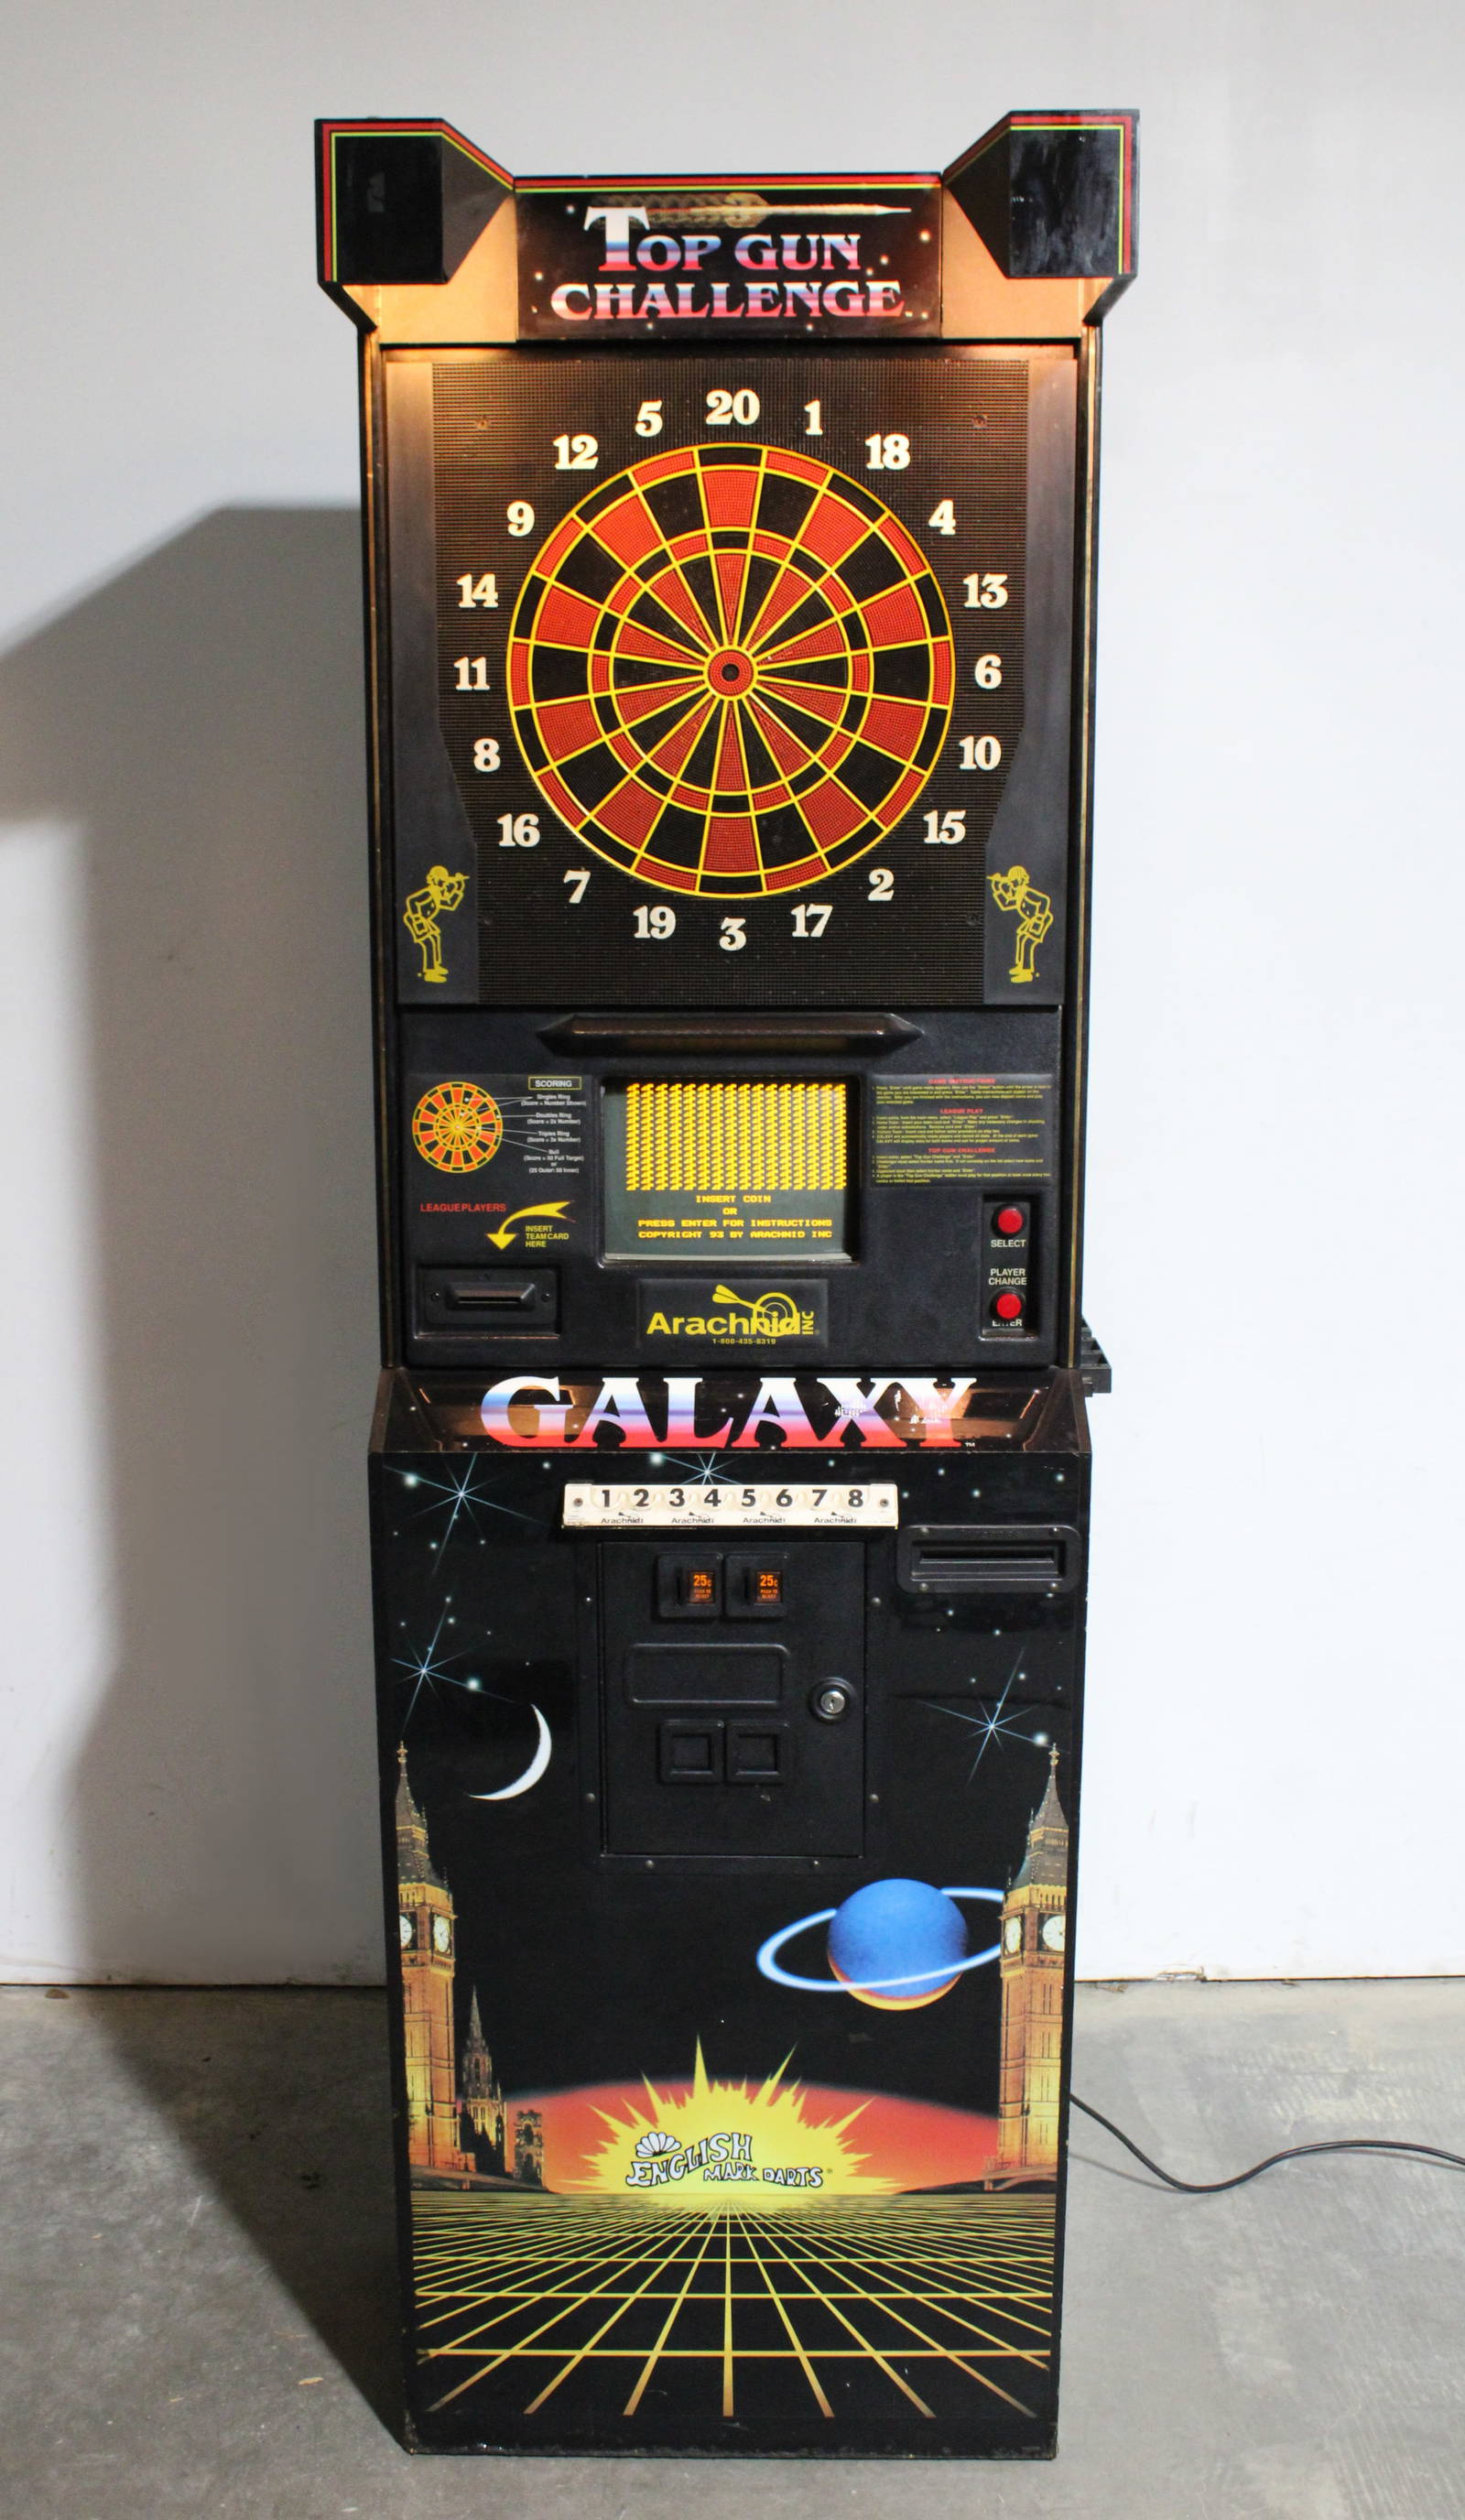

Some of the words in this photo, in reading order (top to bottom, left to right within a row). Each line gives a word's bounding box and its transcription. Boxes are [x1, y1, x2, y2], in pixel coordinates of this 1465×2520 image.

[583, 206, 722, 272] TOP
[733, 234, 861, 270] GUN
[550, 279, 906, 320] CHALLENGE
[635, 400, 663, 438] 5
[706, 390, 760, 426] 20
[804, 400, 823, 436] 1
[553, 435, 599, 470] 12
[864, 434, 911, 470] 18
[506, 502, 535, 537] 9
[928, 500, 956, 536] 4
[457, 574, 499, 608] 14
[962, 573, 1008, 609] 13
[453, 657, 491, 690] 11
[974, 655, 1002, 690] 6
[473, 738, 501, 772] 8
[959, 736, 1002, 770] 10
[497, 813, 540, 847] 16
[923, 810, 966, 844] 15
[563, 870, 591, 904] 7
[868, 869, 895, 901] 2
[633, 906, 677, 940] 19
[719, 917, 746, 951] 3
[790, 904, 833, 938] 17
[535, 1080, 572, 1088] SCORING
[419, 1203, 461, 1212] LEAGUE
[461, 1203, 506, 1212] PLAYERS
[696, 1195, 736, 1203] INSERT
[743, 1195, 771, 1203] COIN
[722, 1207, 737, 1215] OR
[991, 1240, 1026, 1248] SELECT
[988, 1277, 1027, 1286] CHANGE
[990, 1268, 1026, 1276] PLAYER
[646, 1311, 801, 1336] Arachnid
[802, 1310, 814, 1335] INC
[480, 1375, 977, 1449] GALAXY
[602, 1489, 610, 1507] 1
[634, 1488, 649, 1507] 2
[669, 1488, 685, 1507] 3
[704, 1489, 722, 1507] 4
[741, 1489, 755, 1507] 5
[776, 1489, 793, 1507] 6
[812, 1489, 828, 1506] 7
[848, 1489, 863, 1507] 8
[625, 2132, 753, 2187] ENGLISH
[703, 2162, 759, 2181] MARK
[762, 2167, 823, 2188] DARTS
